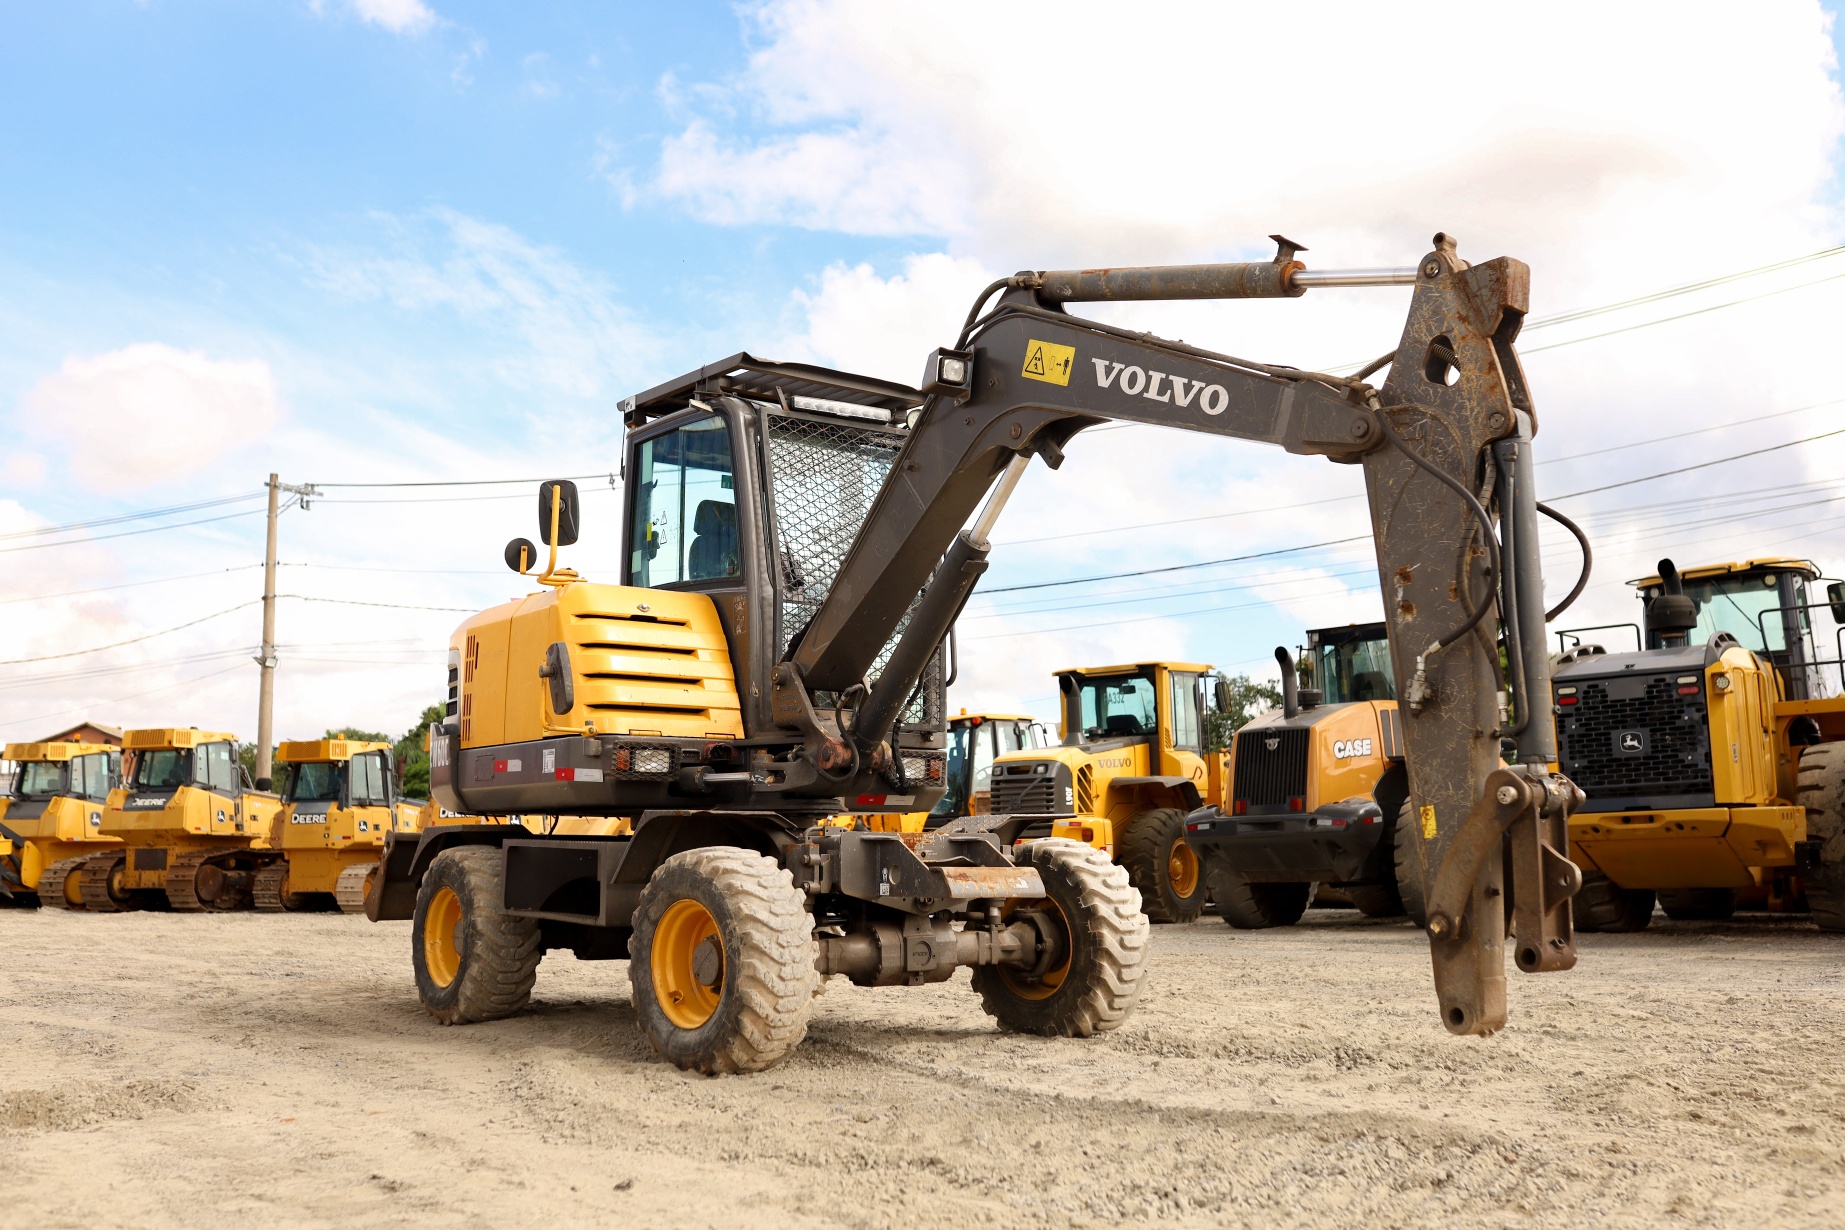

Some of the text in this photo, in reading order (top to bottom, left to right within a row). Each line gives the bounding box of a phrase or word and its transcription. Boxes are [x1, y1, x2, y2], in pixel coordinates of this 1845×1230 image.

[1091, 357, 1229, 416] VOLVO
[1333, 738, 1371, 760] CASE
[1098, 758, 1132, 769] VOLVO
[1065, 787, 1073, 806] L90F
[291, 813, 327, 824] DEERE
